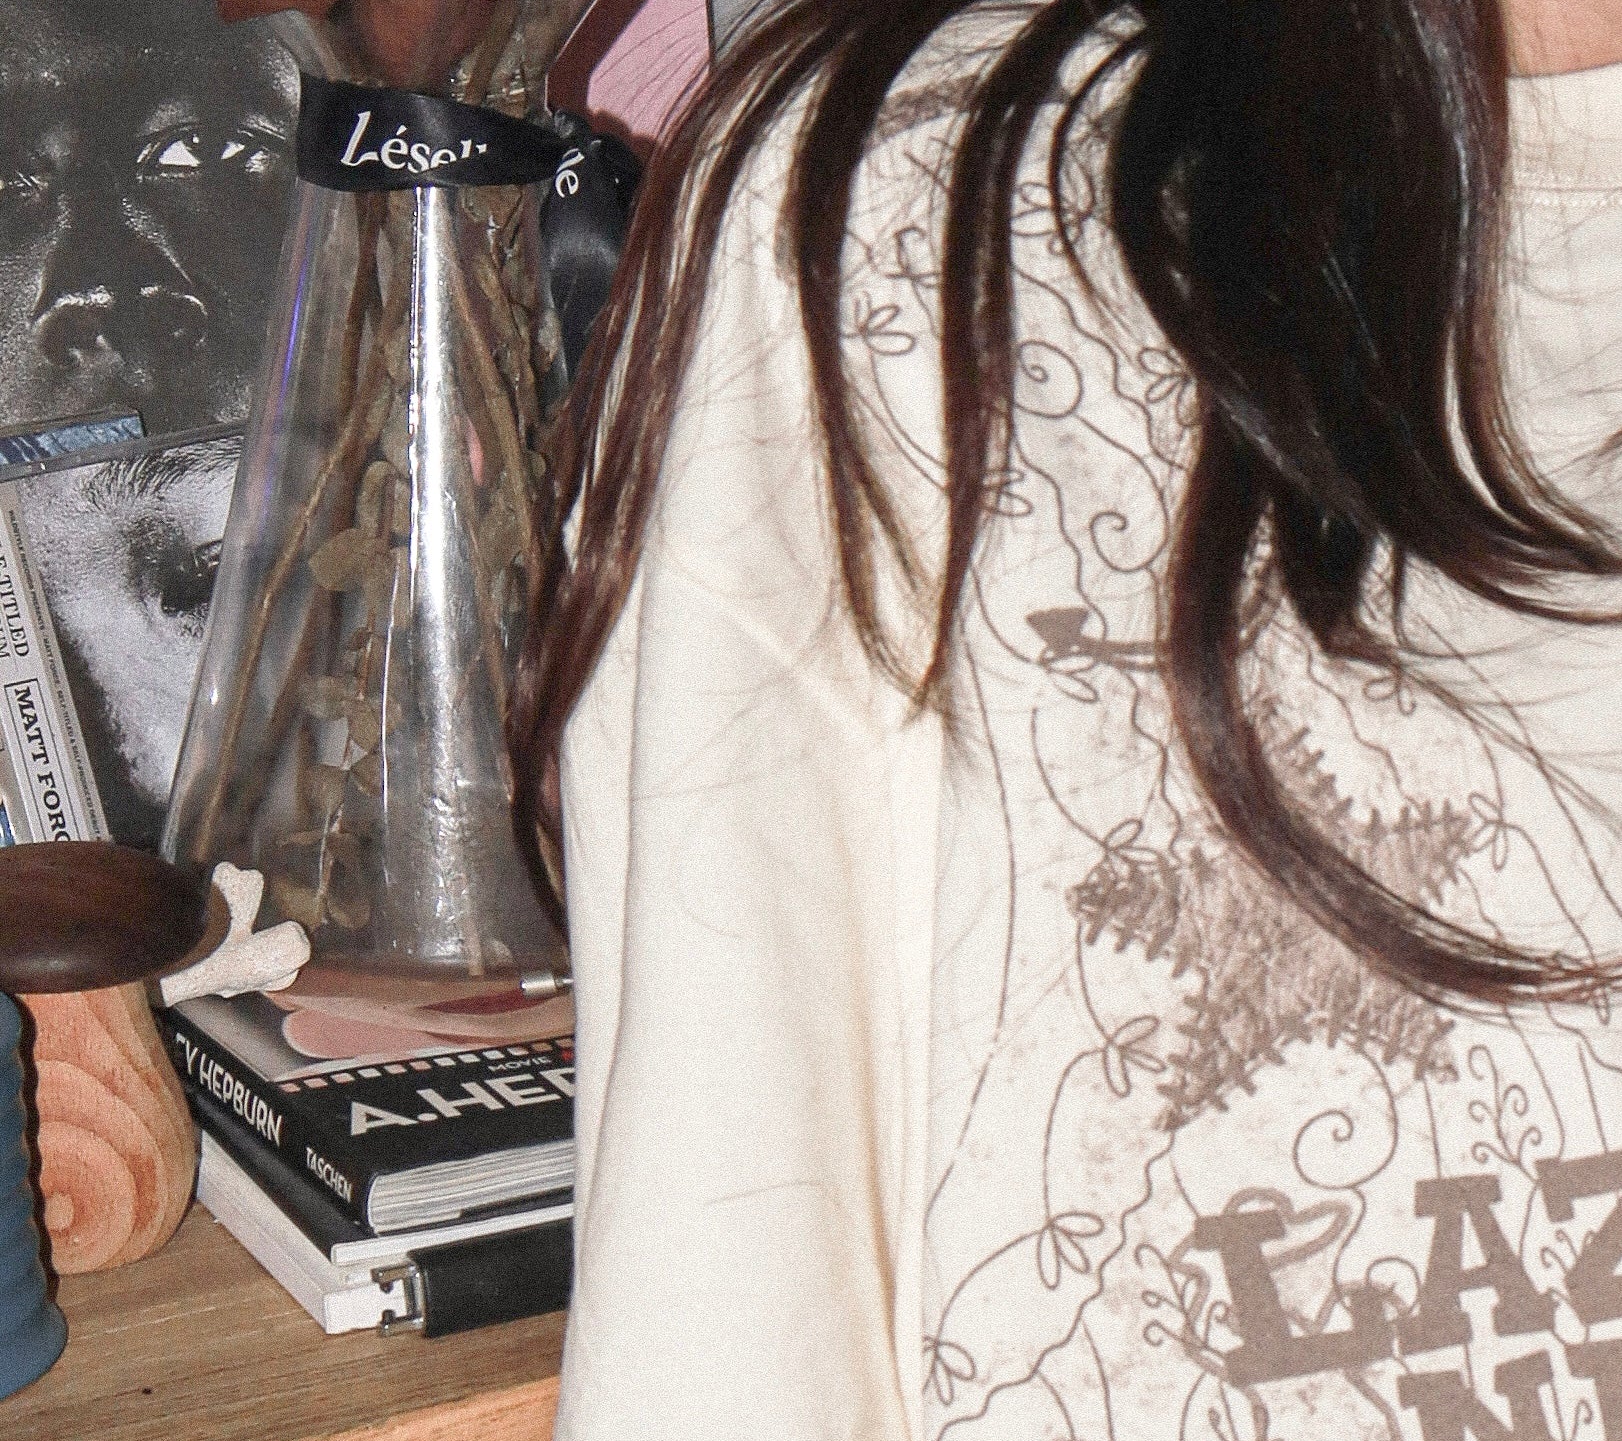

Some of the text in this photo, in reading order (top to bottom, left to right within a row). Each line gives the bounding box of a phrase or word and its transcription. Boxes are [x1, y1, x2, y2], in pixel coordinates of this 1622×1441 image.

[0, 574, 30, 658] TITLED
[14, 685, 50, 766] MATT
[200, 1053, 283, 1147] HEPBURN
[487, 1055, 552, 1072] MOVIE
[306, 1146, 352, 1203] TASCHEN
